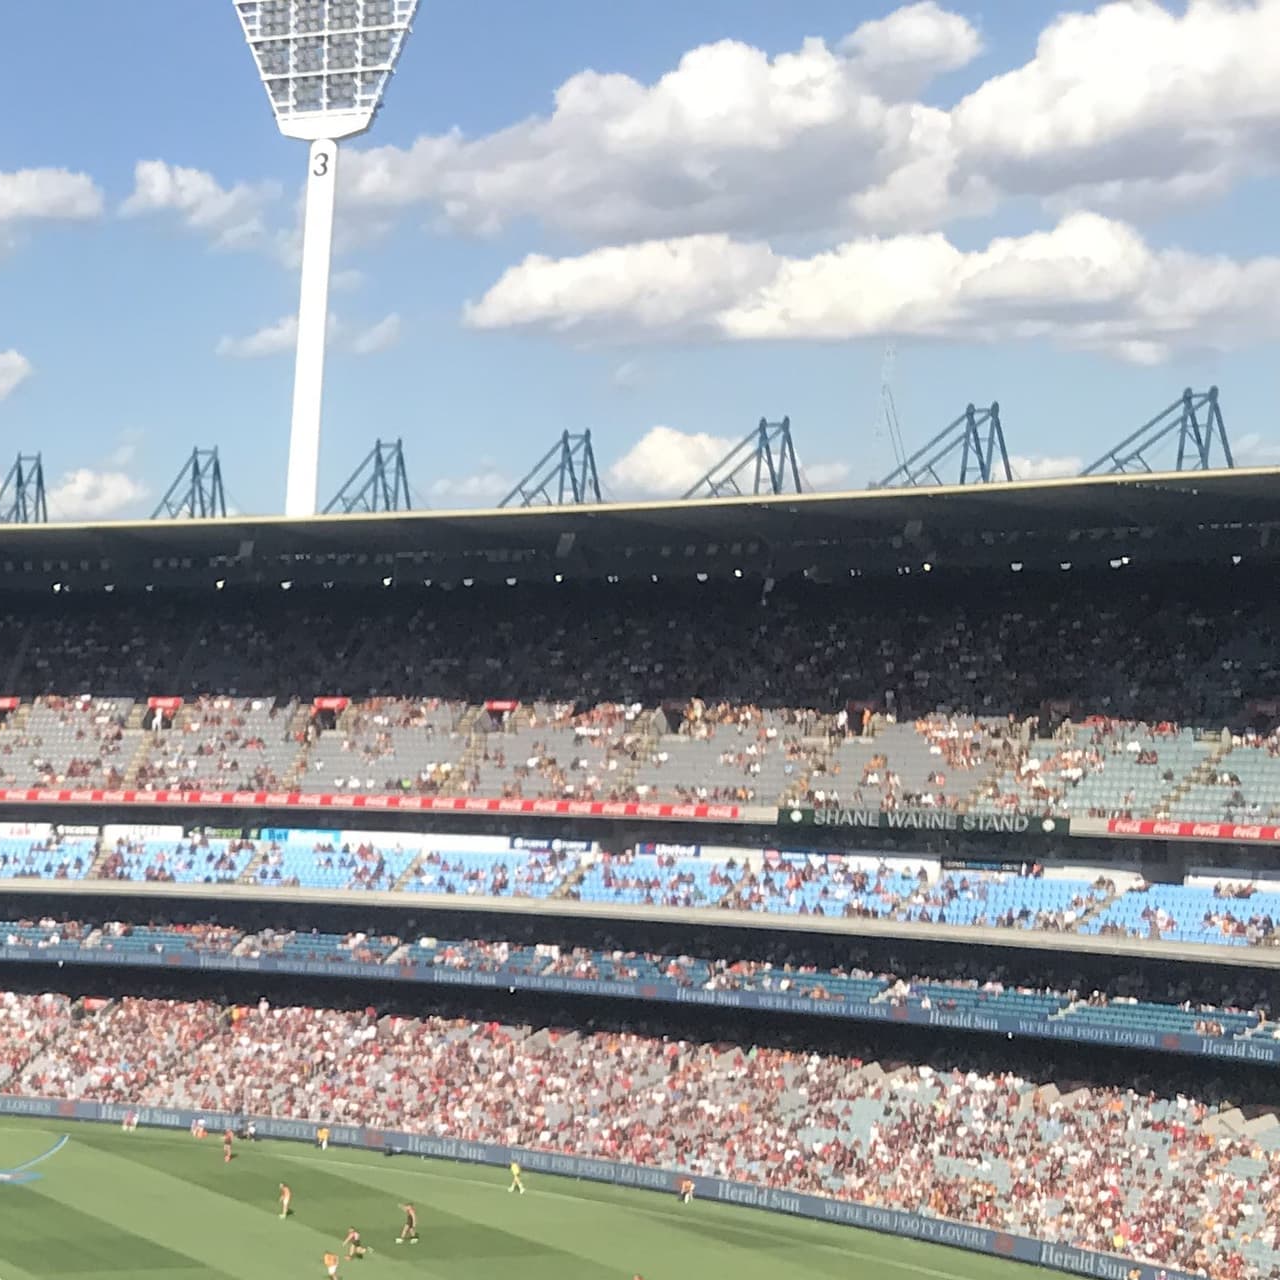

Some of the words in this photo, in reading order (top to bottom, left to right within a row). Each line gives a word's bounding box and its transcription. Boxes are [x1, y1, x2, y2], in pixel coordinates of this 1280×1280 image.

[312, 152, 329, 177] 3
[813, 808, 880, 828] SHANE
[886, 811, 957, 831] WARNE
[961, 814, 1029, 833] STAND
[929, 1010, 972, 1028] Herald
[974, 1016, 999, 1031] Sun
[1018, 1019, 1051, 1034] WE'RE
[1053, 1022, 1074, 1036] FOR
[1076, 1026, 1109, 1042] FOOTY
[1111, 1029, 1155, 1047] LOVERS
[1201, 1038, 1244, 1058] Herald
[1246, 1043, 1274, 1061] Sun
[718, 1182, 768, 1204] Herald
[771, 1194, 801, 1213] Sun
[824, 1201, 864, 1218] WE'RE
[866, 1211, 891, 1227] FOR
[894, 1214, 937, 1235] FOOTY
[939, 1225, 987, 1248] LOVERS
[1040, 1242, 1095, 1273] Herald
[1096, 1257, 1128, 1279] Sun
